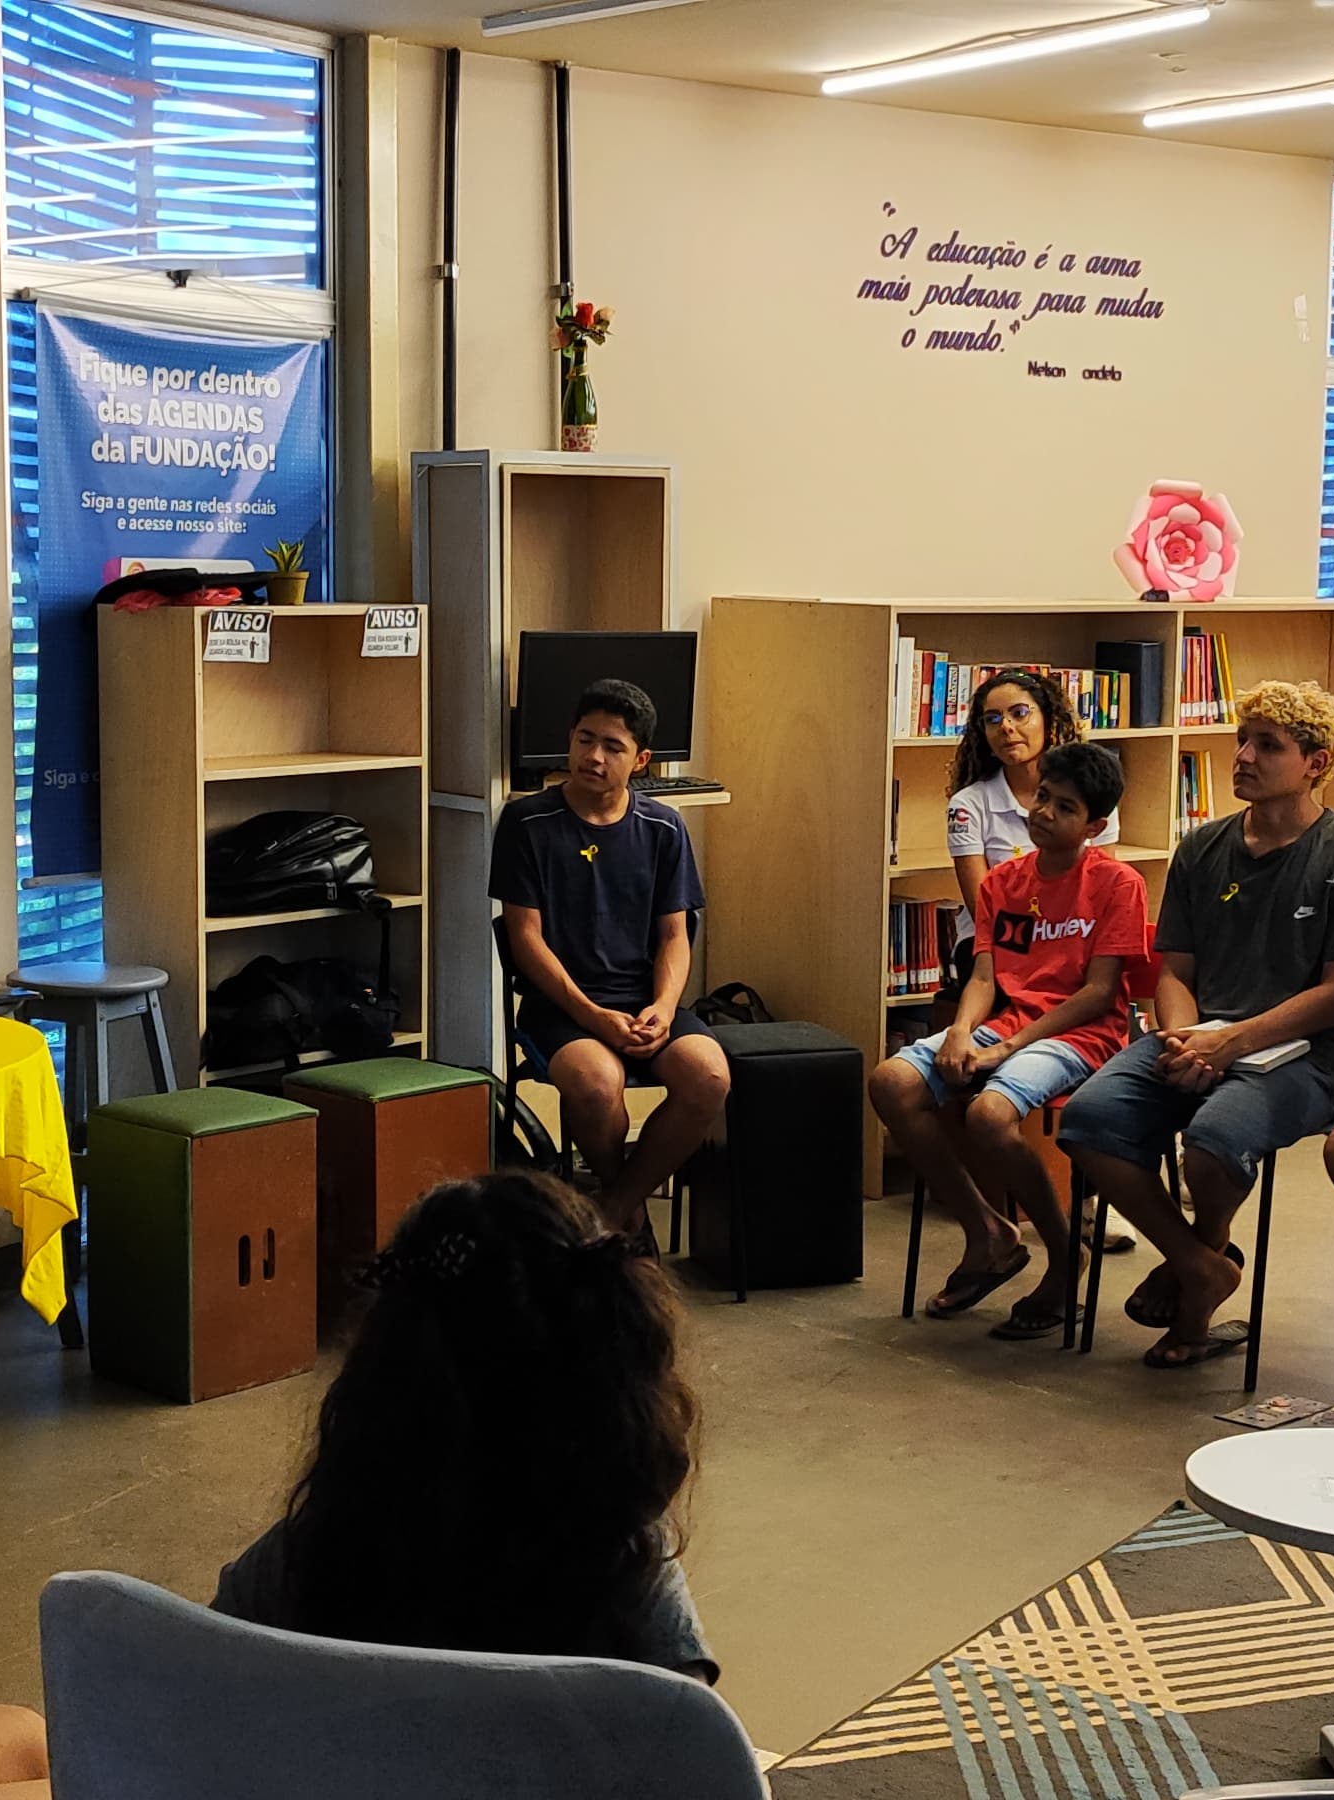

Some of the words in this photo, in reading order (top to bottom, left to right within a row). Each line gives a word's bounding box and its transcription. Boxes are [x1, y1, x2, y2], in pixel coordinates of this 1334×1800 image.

[926, 230, 1027, 270] educação
[1034, 244, 1053, 269] é
[1059, 252, 1077, 272] a
[1085, 252, 1142, 279] arma
[856, 275, 912, 302] mais
[908, 274, 1022, 317] poderosa
[1021, 291, 1087, 322] para
[1094, 288, 1165, 320] mudar
[901, 327, 917, 349] o
[79, 352, 148, 392] Fique
[152, 365, 196, 396] por
[198, 365, 282, 399] dentro
[1027, 360, 1067, 378] Nelson
[98, 394, 144, 426] das
[146, 398, 264, 434] AGENDAS
[91, 433, 126, 464] da
[130, 435, 276, 476] FUNDAÇÃO!
[81, 491, 114, 514] Siga
[116, 498, 126, 511] a
[127, 496, 168, 516] gente
[170, 498, 193, 512] nas
[195, 498, 233, 515] redes
[234, 499, 278, 515] sociais
[117, 518, 127, 530] e
[129, 519, 173, 532] acesse
[175, 520, 215, 533] nosso
[217, 518, 247, 534] site:
[213, 612, 266, 631] AVISO
[370, 609, 415, 628] AVISO
[44, 769, 77, 789] Siga
